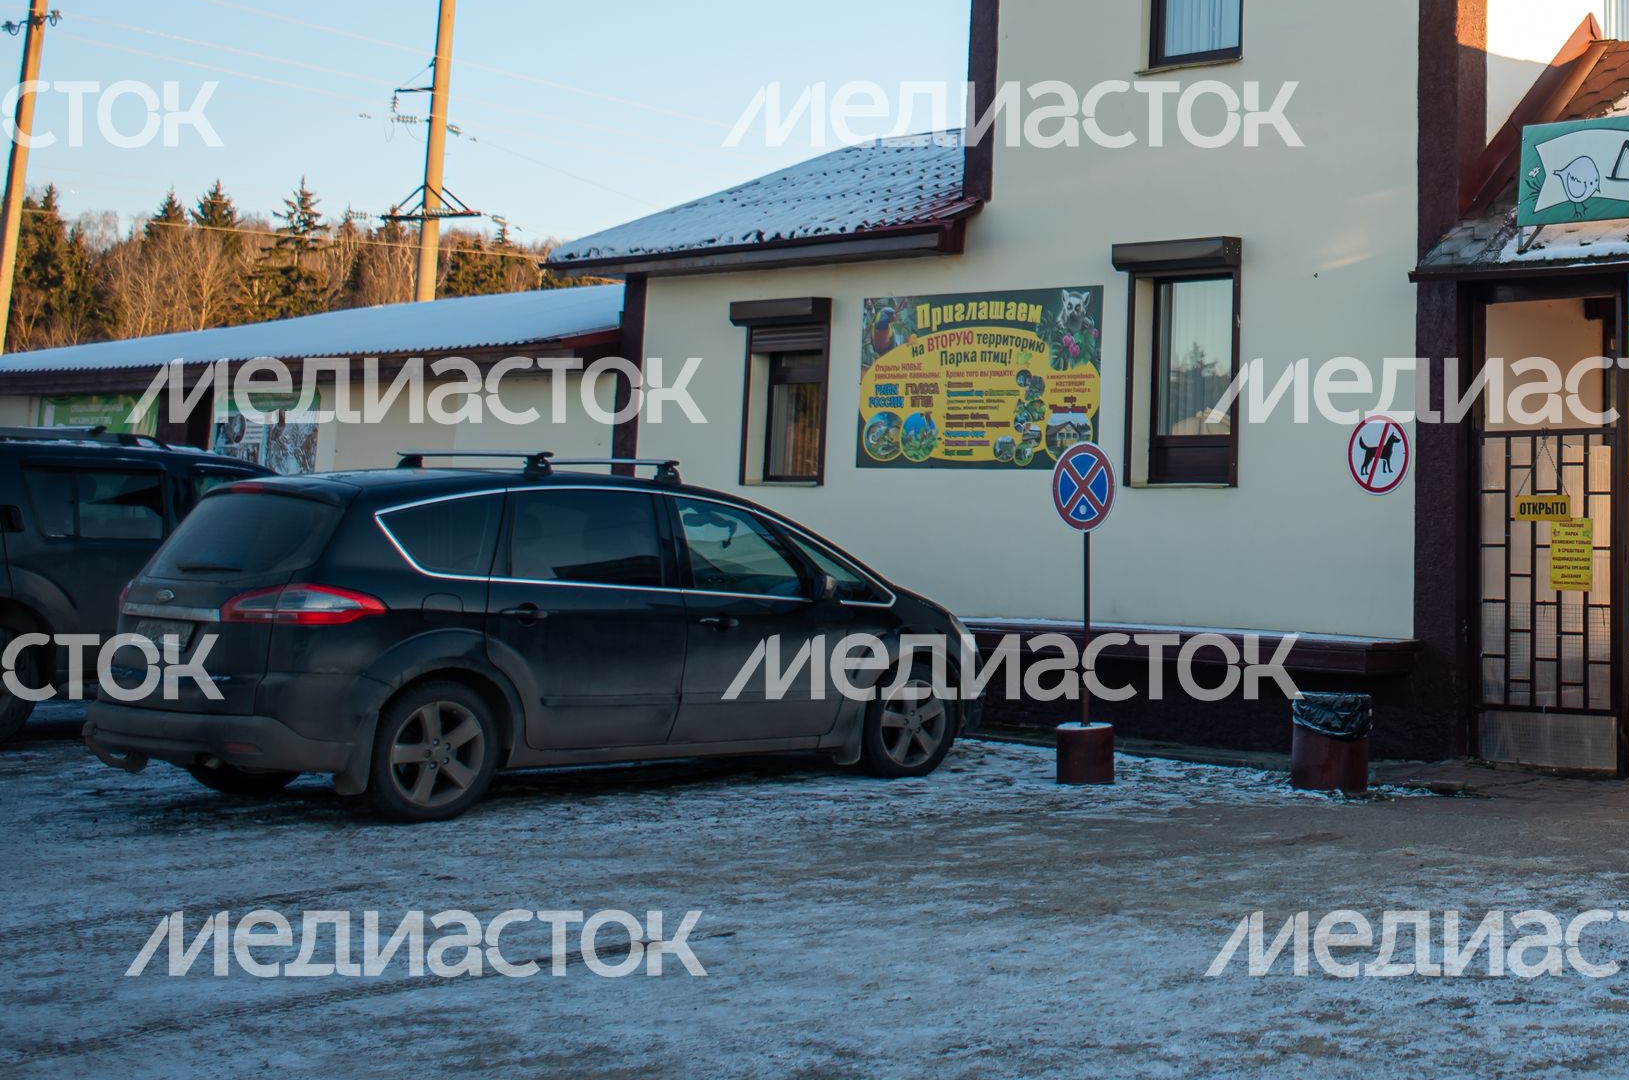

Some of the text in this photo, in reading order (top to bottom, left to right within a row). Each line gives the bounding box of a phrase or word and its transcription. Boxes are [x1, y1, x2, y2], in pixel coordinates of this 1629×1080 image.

[916, 301, 1043, 331] Приглашаем
[911, 331, 1045, 357] на ВТОРУЮ территорию
[940, 350, 1012, 367] Парка птиц!
[901, 362, 922, 371] НОВЫЕ
[905, 383, 939, 395] ГОЛОСА
[1519, 502, 1567, 515] ОТКРЫТО
